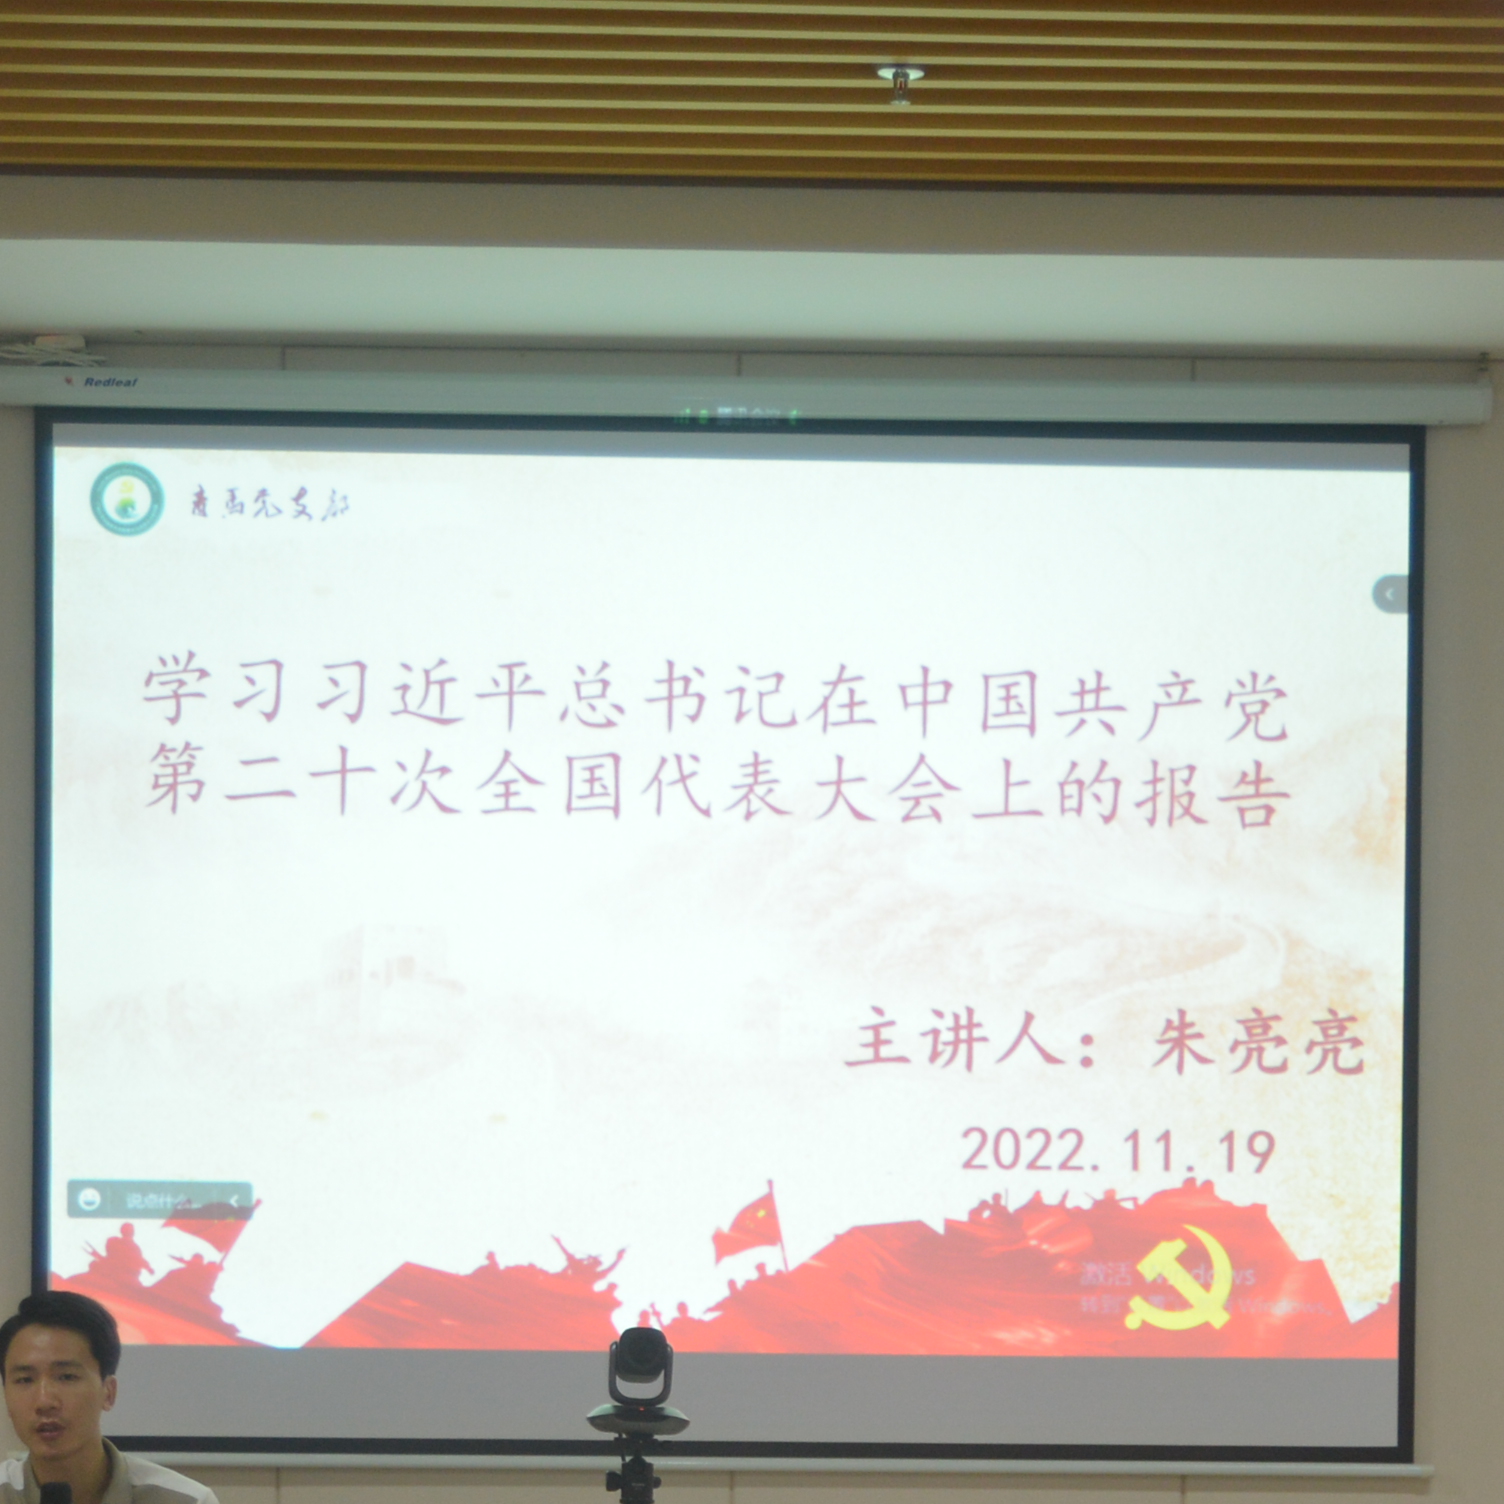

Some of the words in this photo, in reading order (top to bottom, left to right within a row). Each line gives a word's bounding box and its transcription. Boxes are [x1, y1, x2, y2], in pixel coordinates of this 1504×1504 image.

[84, 377, 138, 388] Redleaf
[142, 649, 1289, 744] 学习习近平总书记在中国共产党
[146, 740, 1292, 830] 第二十次全国代表大会上的报告
[960, 1125, 1277, 1176] 2022.11.19
